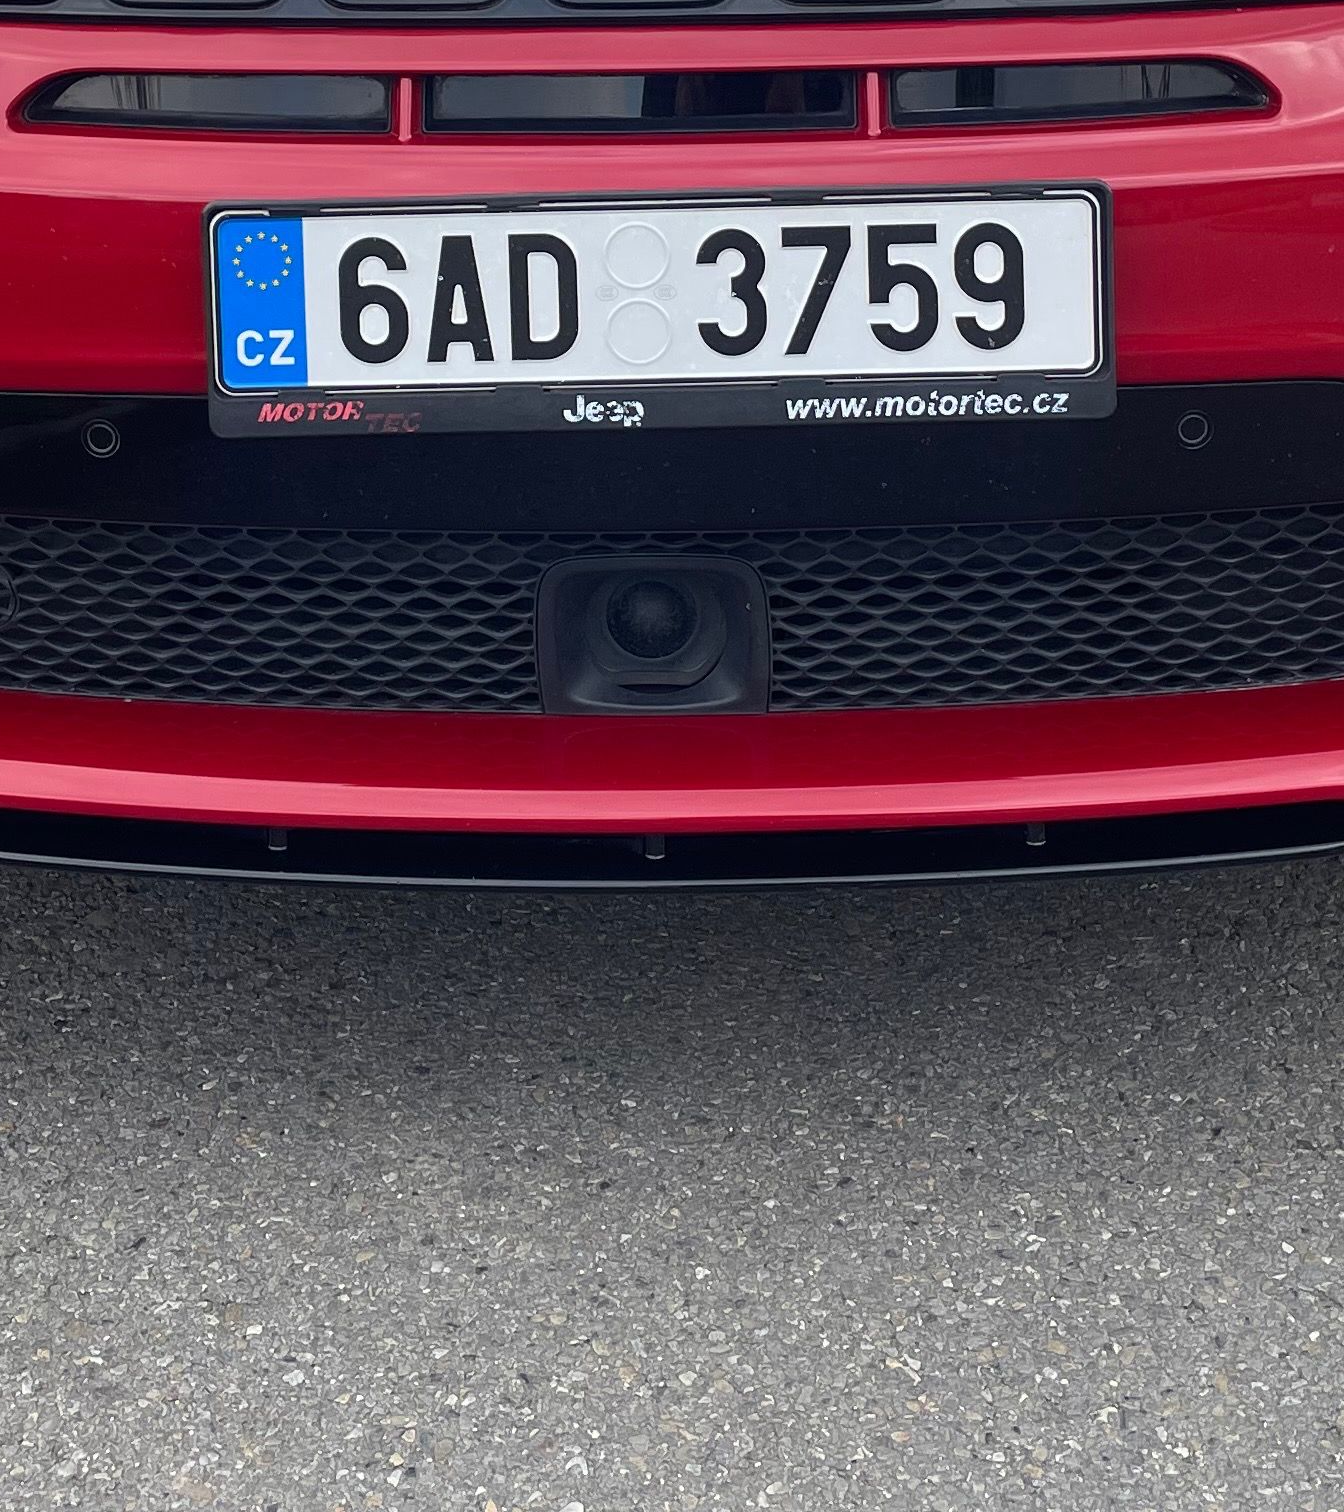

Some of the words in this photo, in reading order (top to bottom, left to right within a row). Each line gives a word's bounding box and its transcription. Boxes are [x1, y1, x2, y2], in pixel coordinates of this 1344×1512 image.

[338, 233, 578, 364] 6AD
[695, 221, 1026, 355] 3759
[236, 330, 296, 366] CZ
[258, 400, 364, 422] MOTOR
[562, 395, 644, 427] Jeep
[785, 389, 1070, 420] www.motortec.cz
